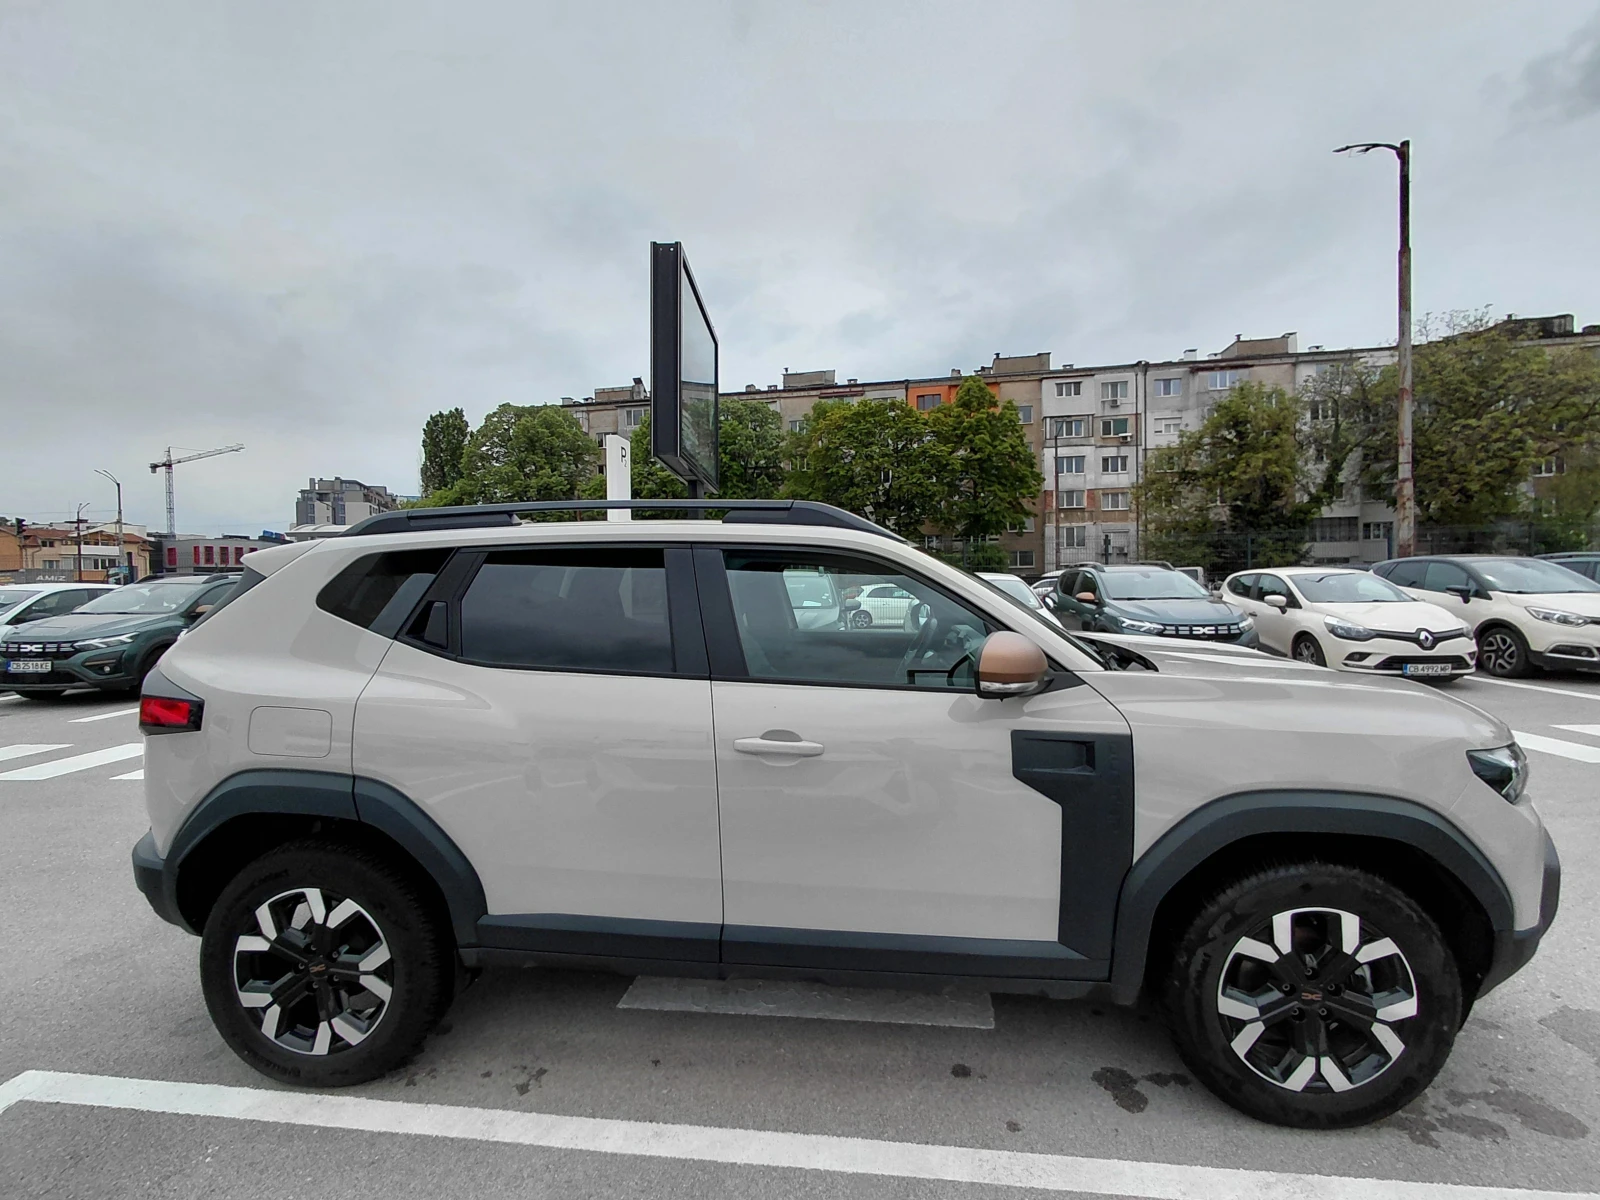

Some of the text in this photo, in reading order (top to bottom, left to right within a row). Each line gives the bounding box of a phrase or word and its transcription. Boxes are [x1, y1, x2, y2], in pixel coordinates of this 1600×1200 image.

[1409, 665, 1450, 673] CB 4992 MP
